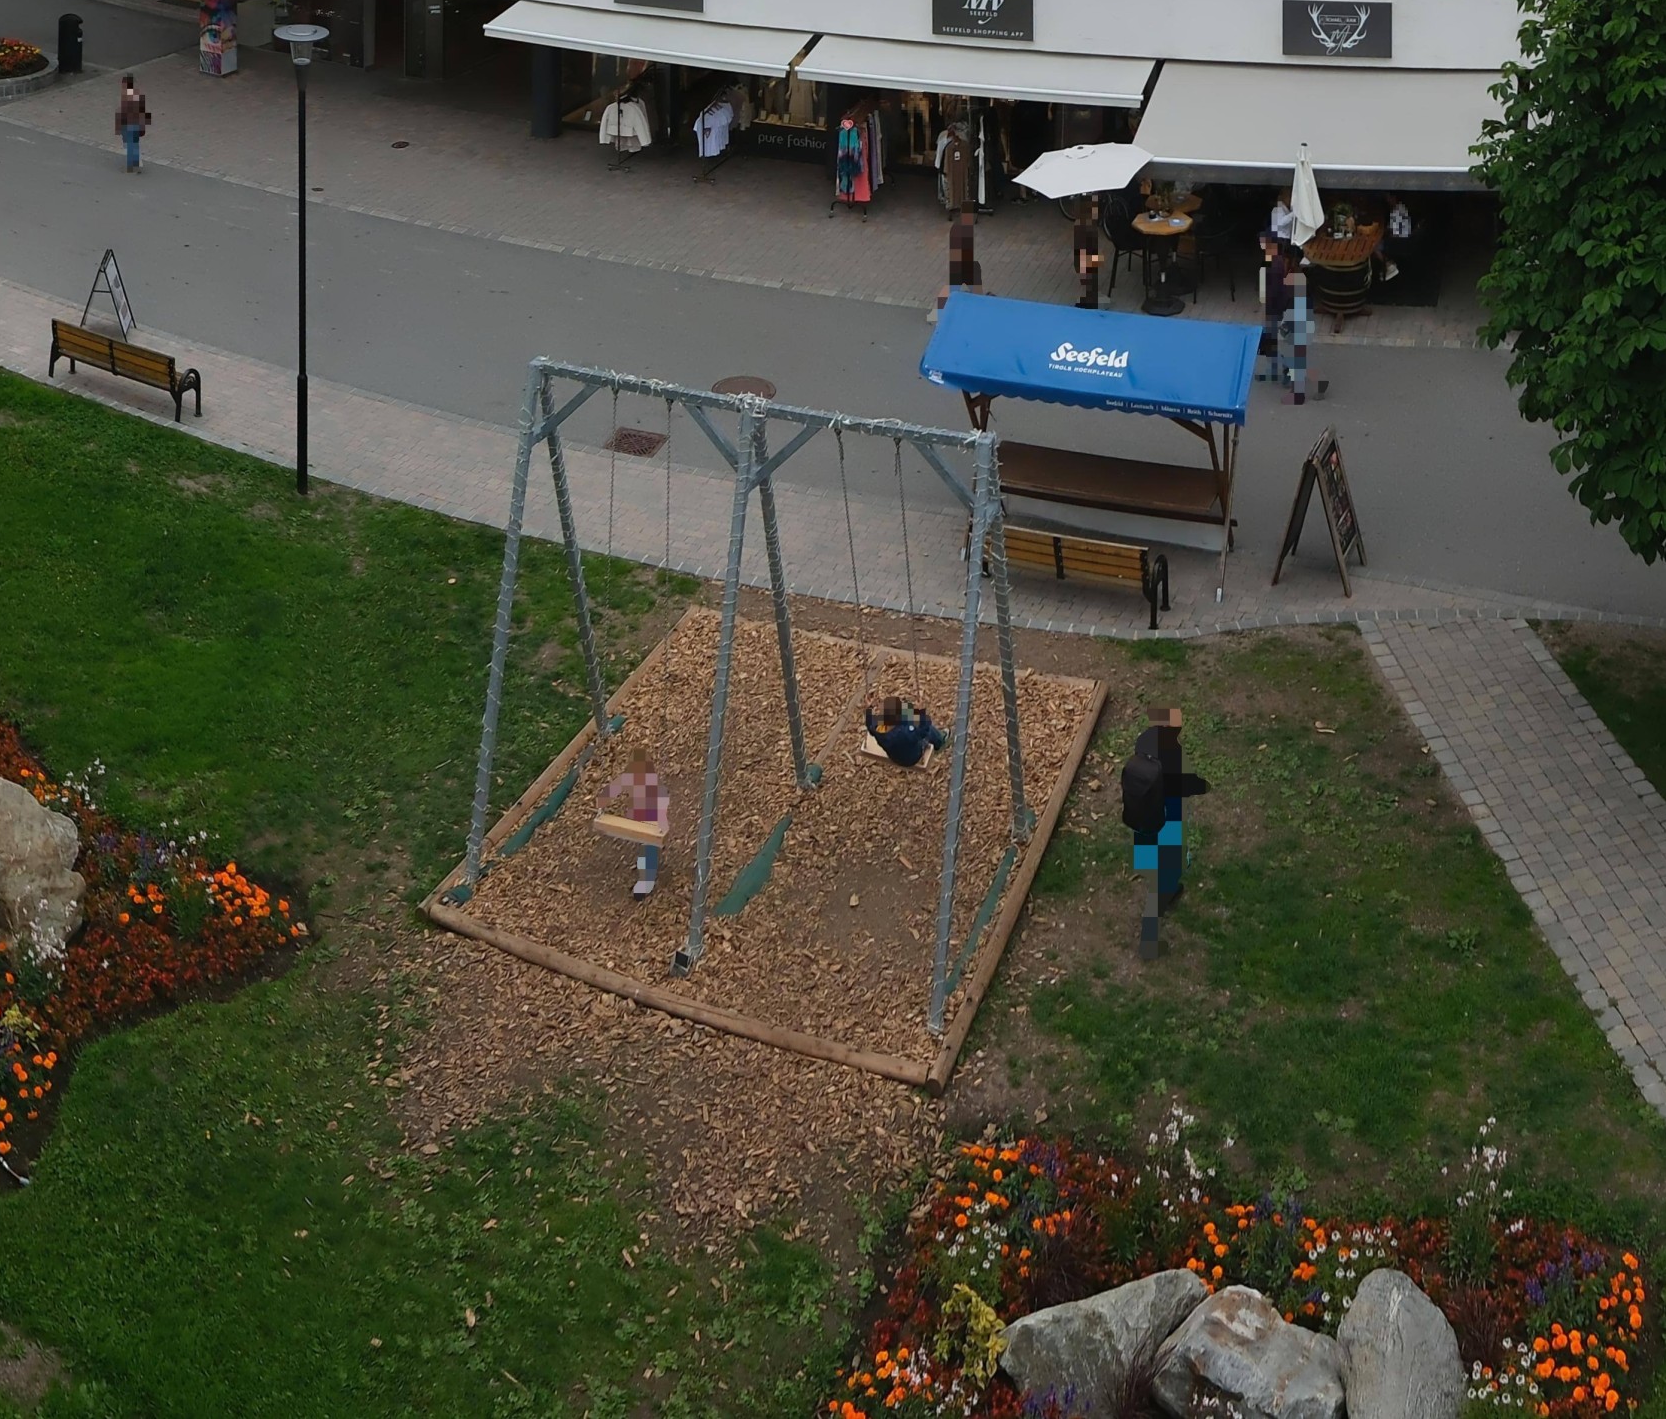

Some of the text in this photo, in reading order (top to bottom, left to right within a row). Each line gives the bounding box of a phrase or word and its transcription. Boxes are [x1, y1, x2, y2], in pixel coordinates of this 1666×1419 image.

[973, 28, 1008, 37] SHOPPING
[758, 133, 784, 145] pure
[1050, 341, 1129, 368] Seefeld
